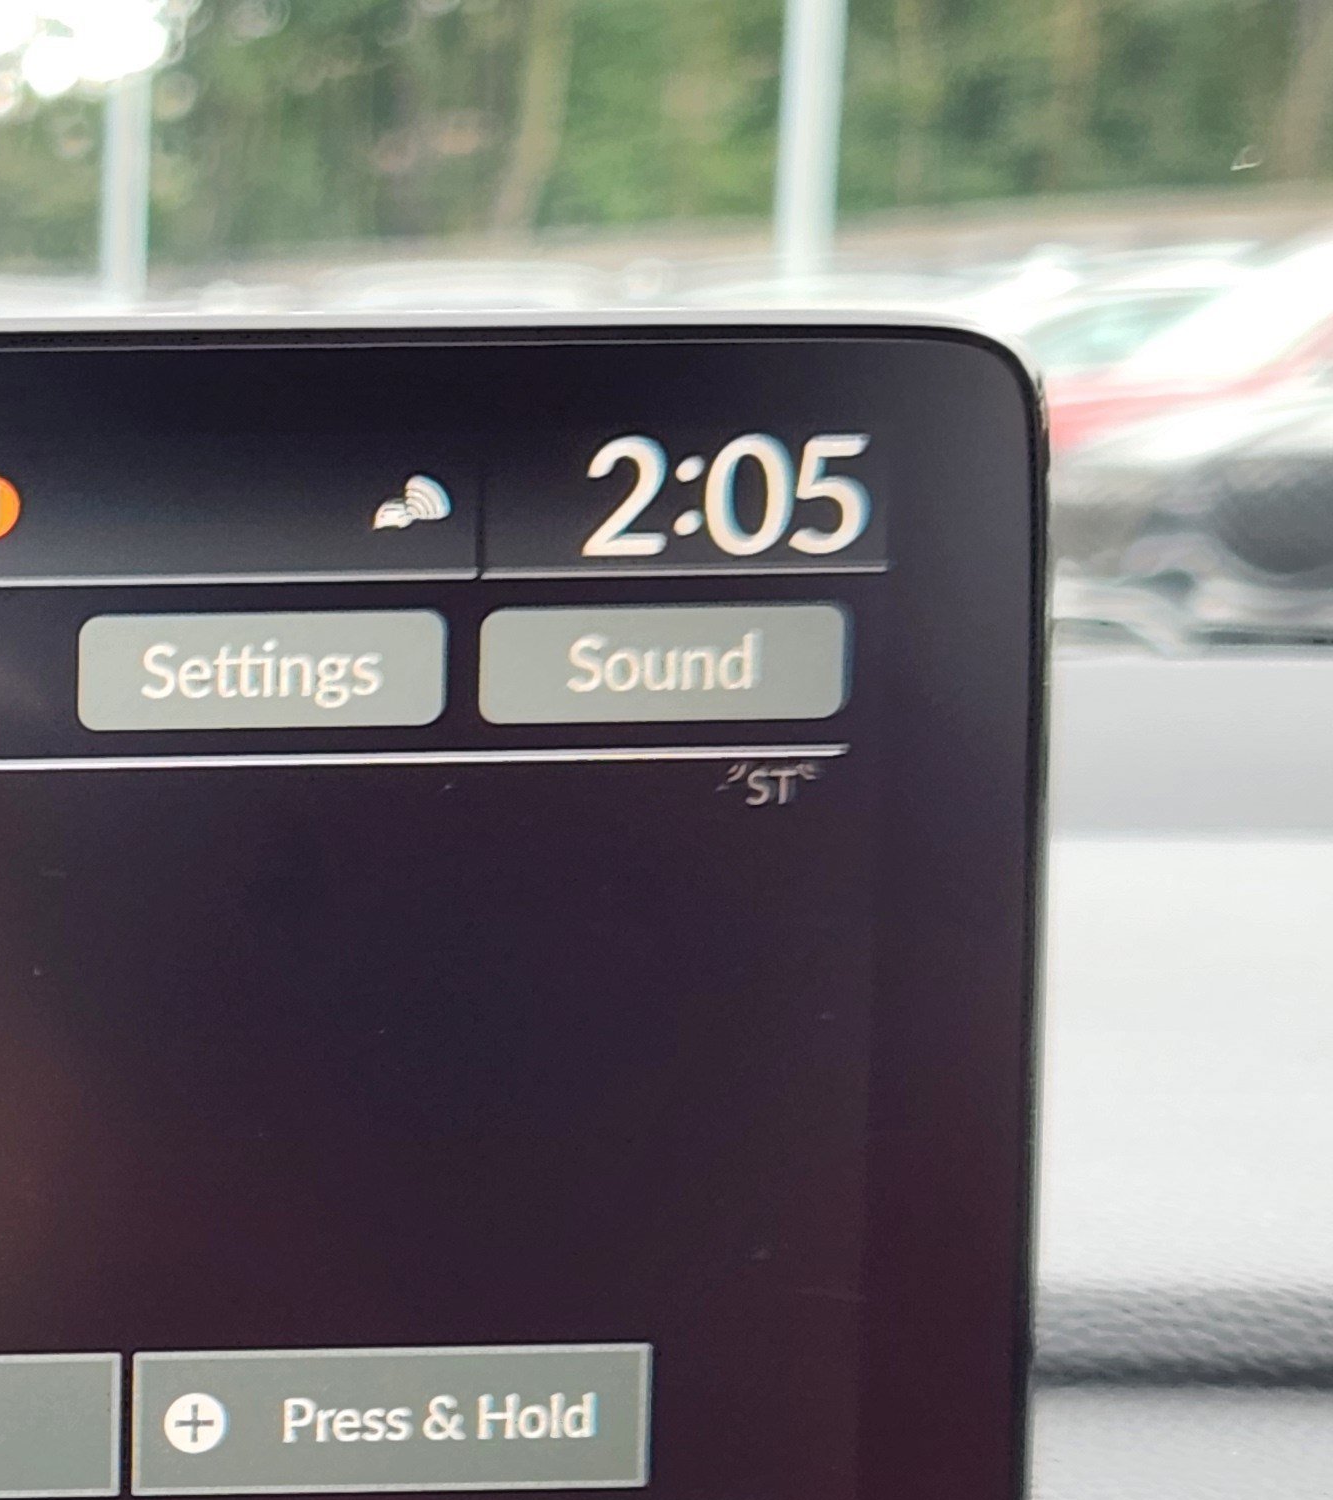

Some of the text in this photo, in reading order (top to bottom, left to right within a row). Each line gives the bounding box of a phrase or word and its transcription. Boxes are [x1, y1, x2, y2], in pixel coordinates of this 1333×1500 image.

[581, 434, 871, 558] 2:05
[139, 639, 383, 708] Settings
[565, 628, 760, 695] Sound
[281, 1390, 597, 1446] Press & Hold
